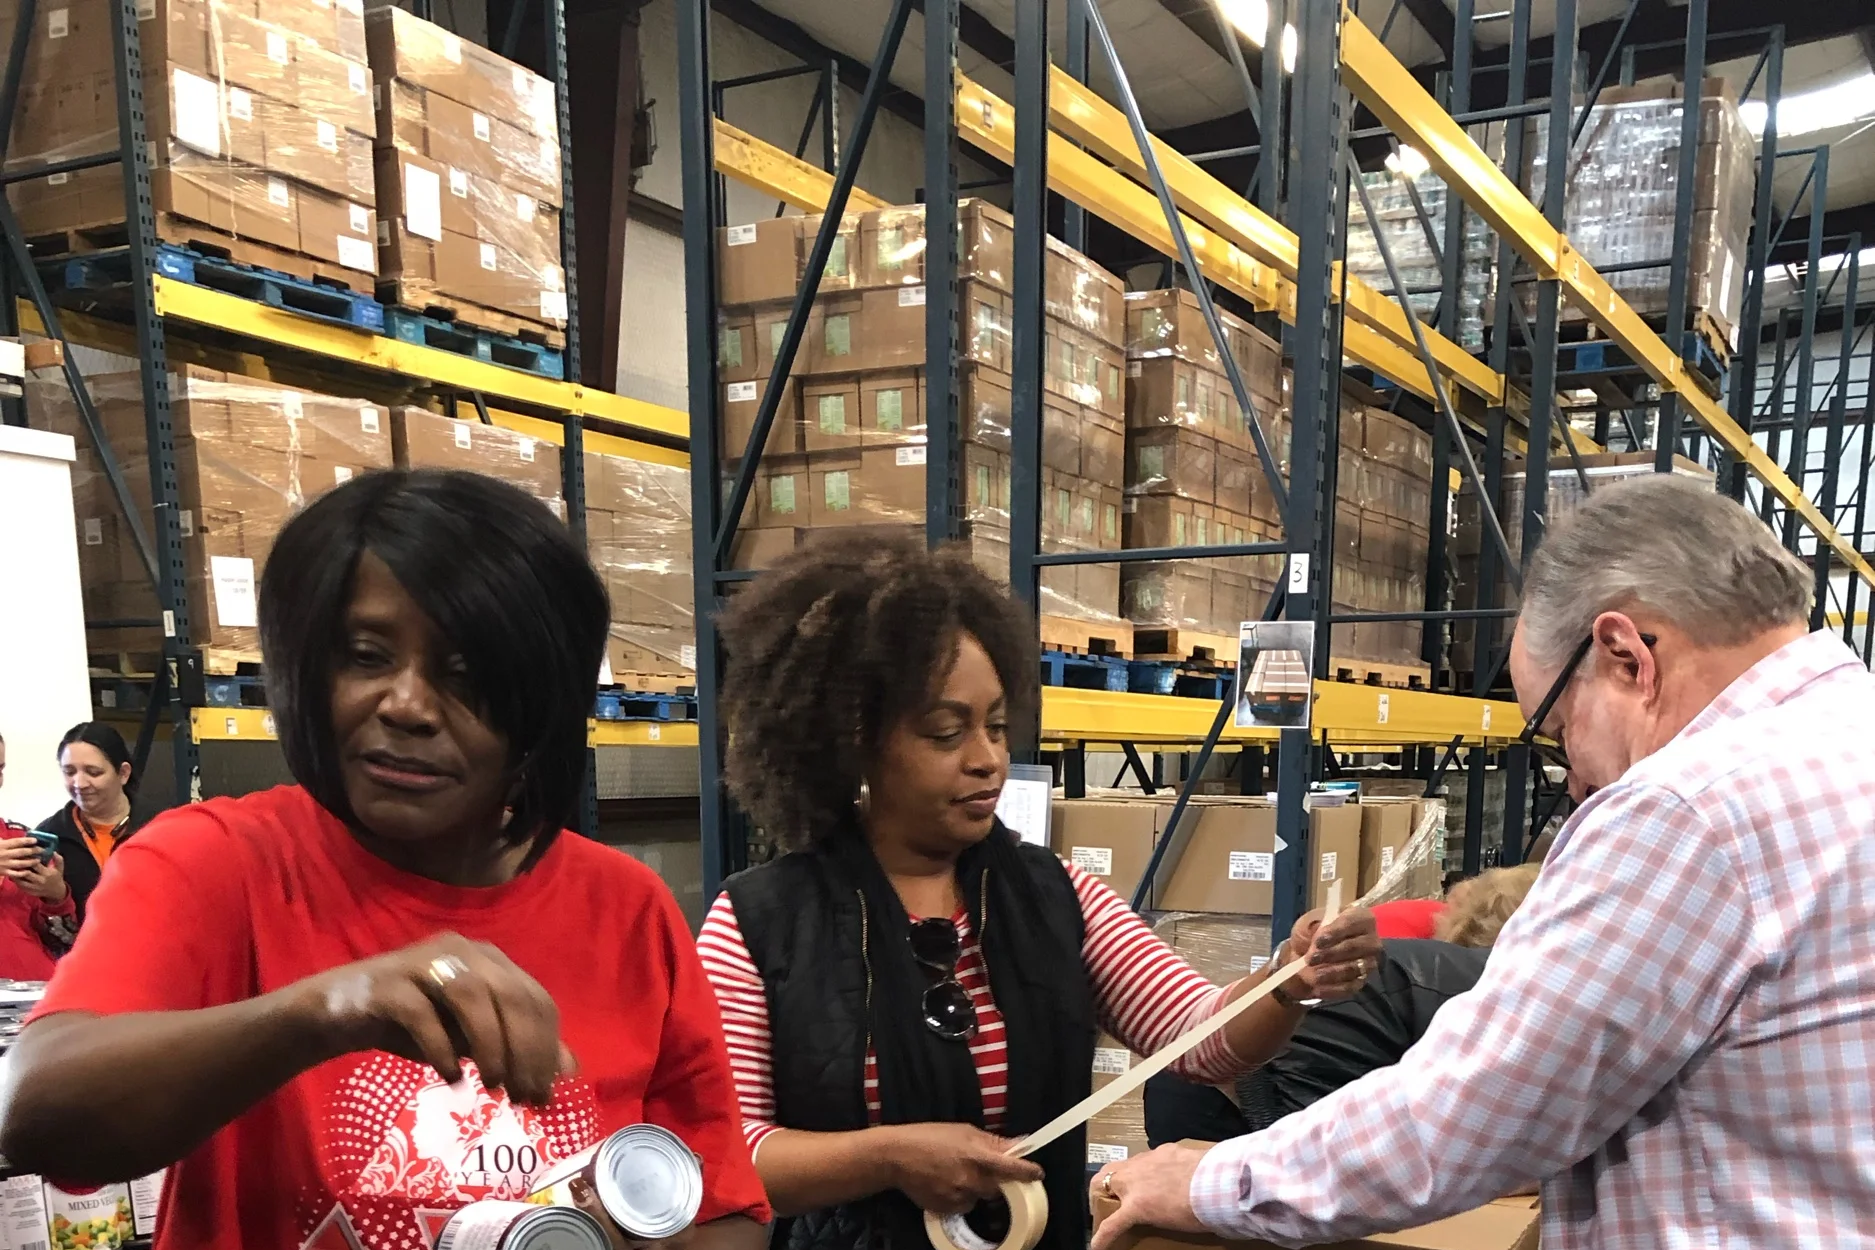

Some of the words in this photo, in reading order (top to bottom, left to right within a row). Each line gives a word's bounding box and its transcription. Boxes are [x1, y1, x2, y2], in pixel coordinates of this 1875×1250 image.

[1293, 561, 1303, 583] 3
[475, 1144, 537, 1174] 100
[461, 1172, 533, 1188] YEAR
[68, 1199, 100, 1212] MIXED
